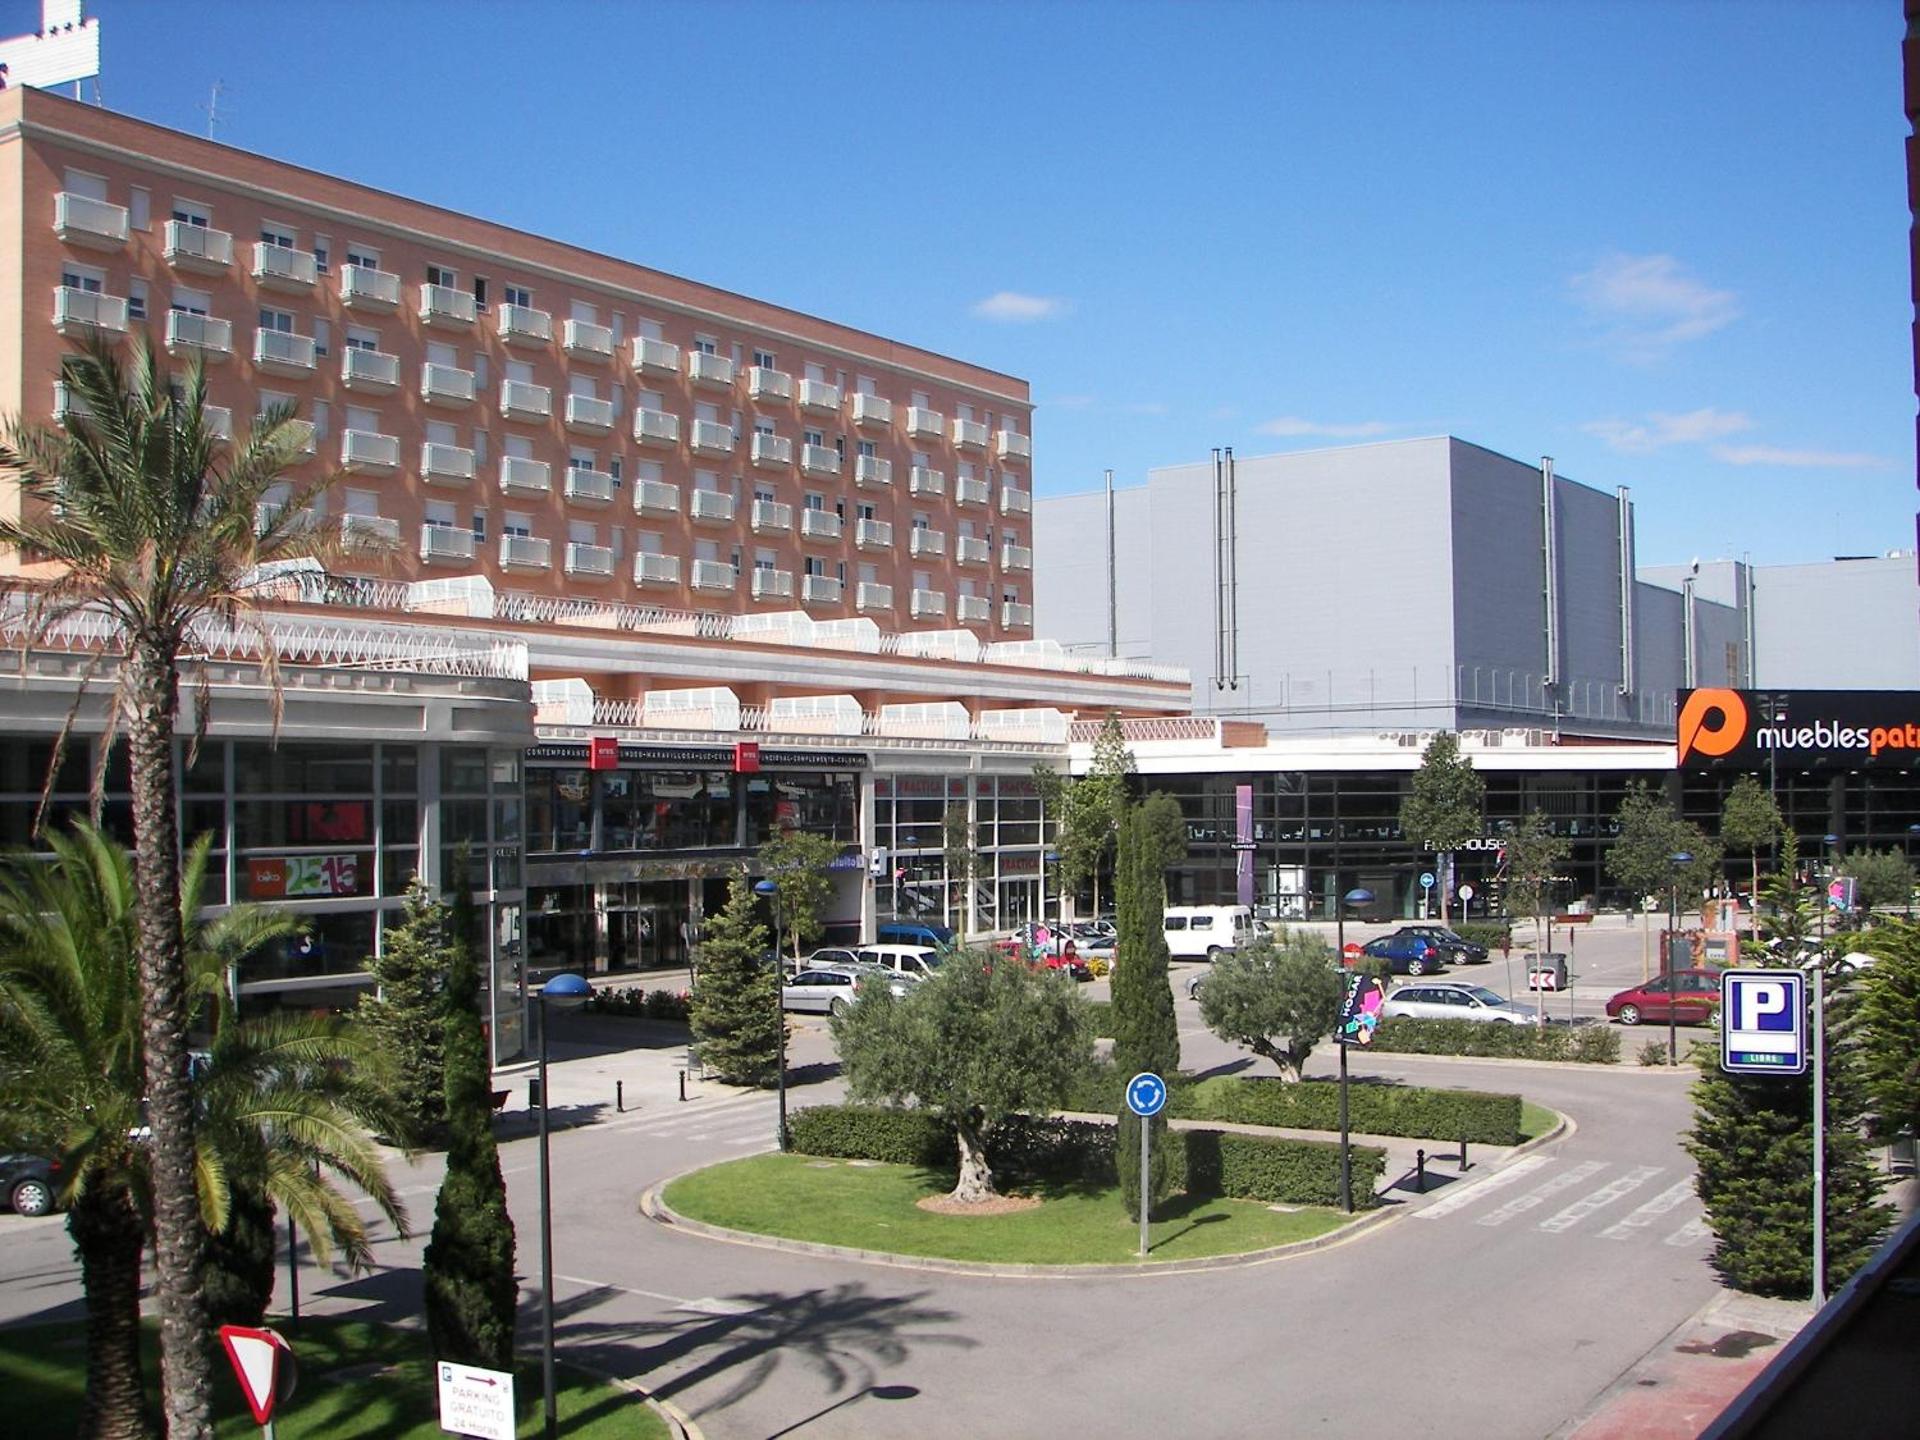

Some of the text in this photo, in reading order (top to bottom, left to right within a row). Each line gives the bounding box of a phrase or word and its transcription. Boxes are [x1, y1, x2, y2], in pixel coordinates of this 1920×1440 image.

[1342, 975, 1363, 1017] HOGAR
[1741, 983, 1785, 1030] P
[450, 1400, 505, 1422] GRATUITO
[452, 1386, 500, 1406] PARKING
